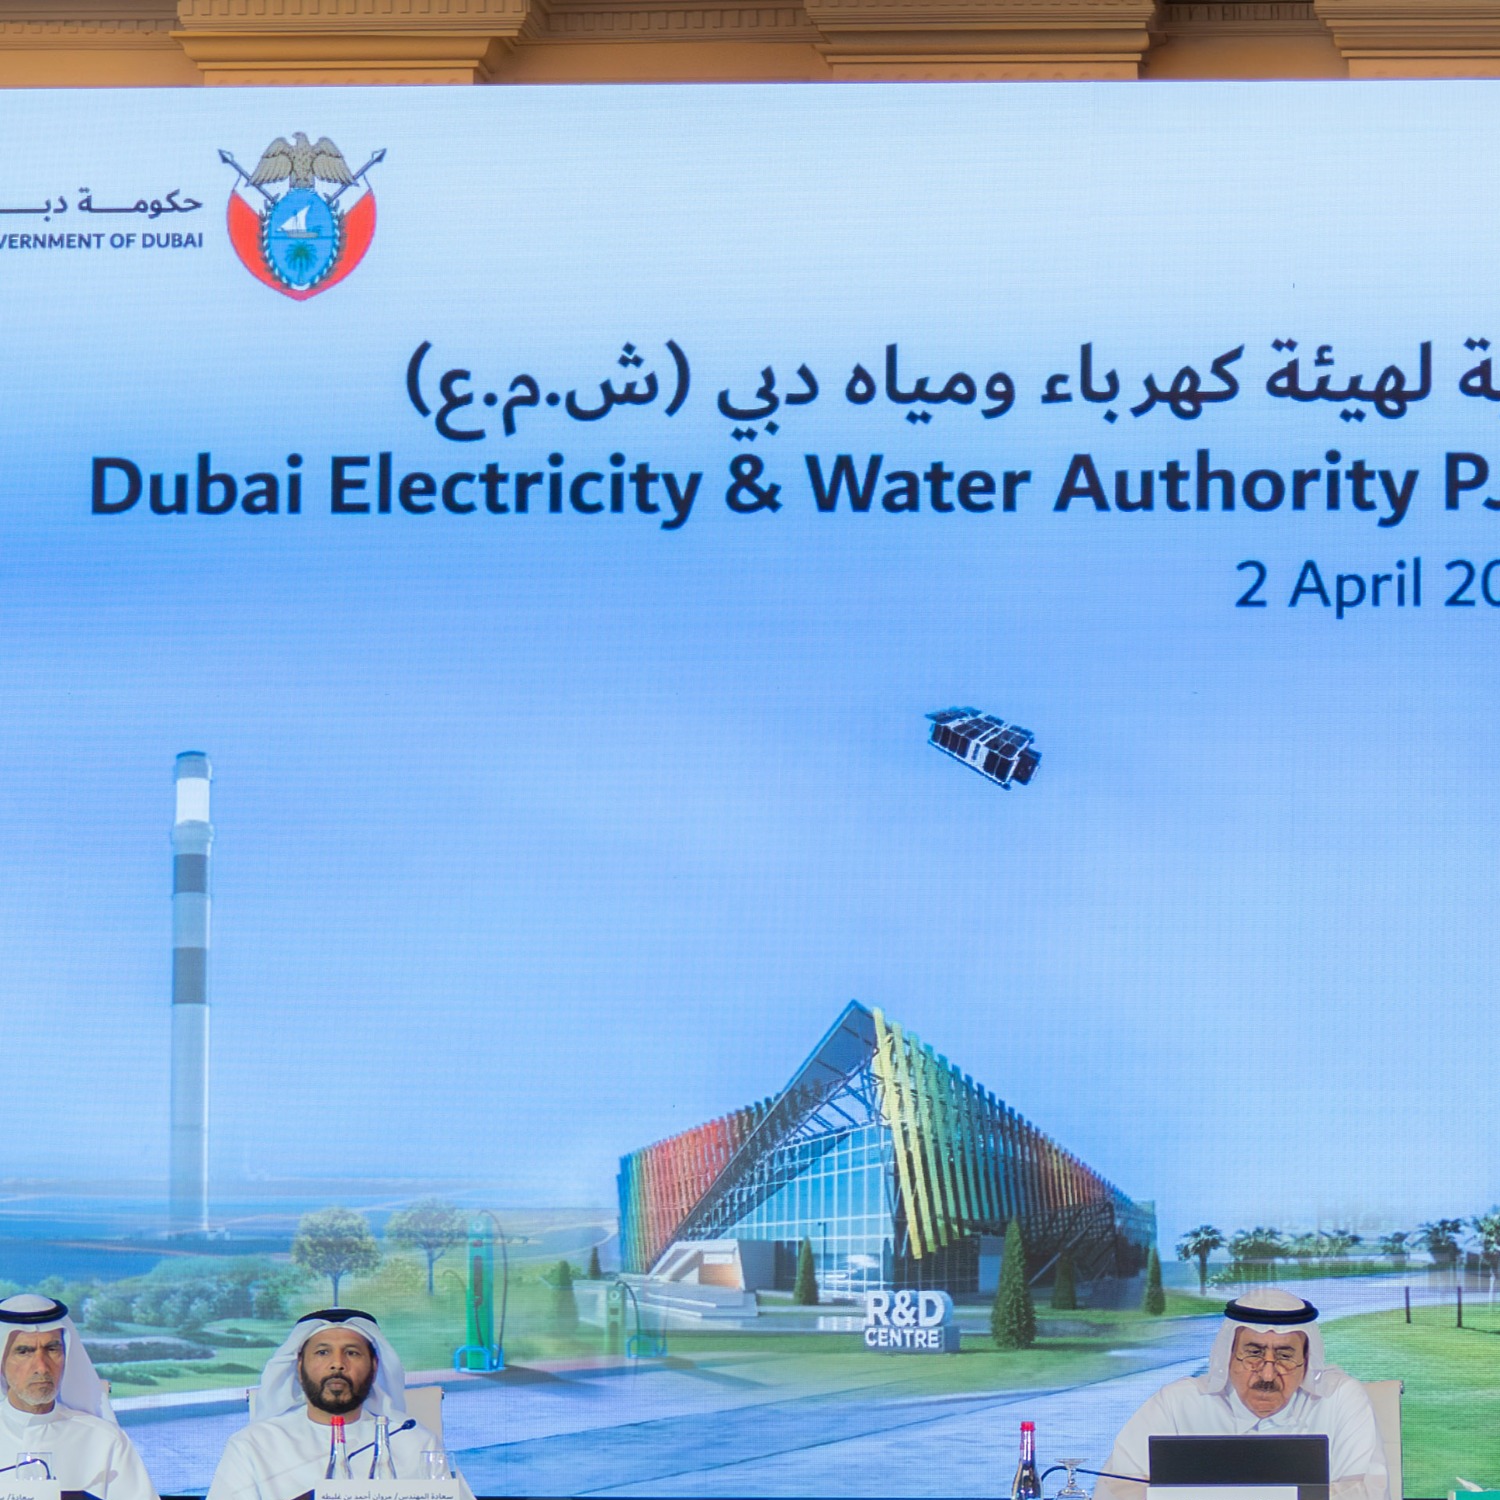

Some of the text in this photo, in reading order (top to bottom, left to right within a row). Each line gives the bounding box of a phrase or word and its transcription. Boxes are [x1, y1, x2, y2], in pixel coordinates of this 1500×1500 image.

[0, 187, 203, 223] حكومة دب
[109, 232, 137, 249] OF
[141, 232, 203, 249] DUBAI
[406, 339, 691, 443] (ش.م.ع)
[716, 363, 820, 442] دبي
[845, 343, 1016, 425] ومياه
[1040, 342, 1245, 424] كهرباء
[1265, 338, 1432, 423] لهيئة
[91, 452, 303, 516] Dubai
[330, 451, 704, 531] Electricity
[725, 453, 783, 514] &
[804, 453, 1032, 514] Water
[1052, 448, 1420, 529] Authority
[1235, 559, 1267, 608] 2
[1288, 556, 1422, 620] April
[865, 1328, 939, 1348] CENTRE
[866, 1290, 945, 1327] R&D
